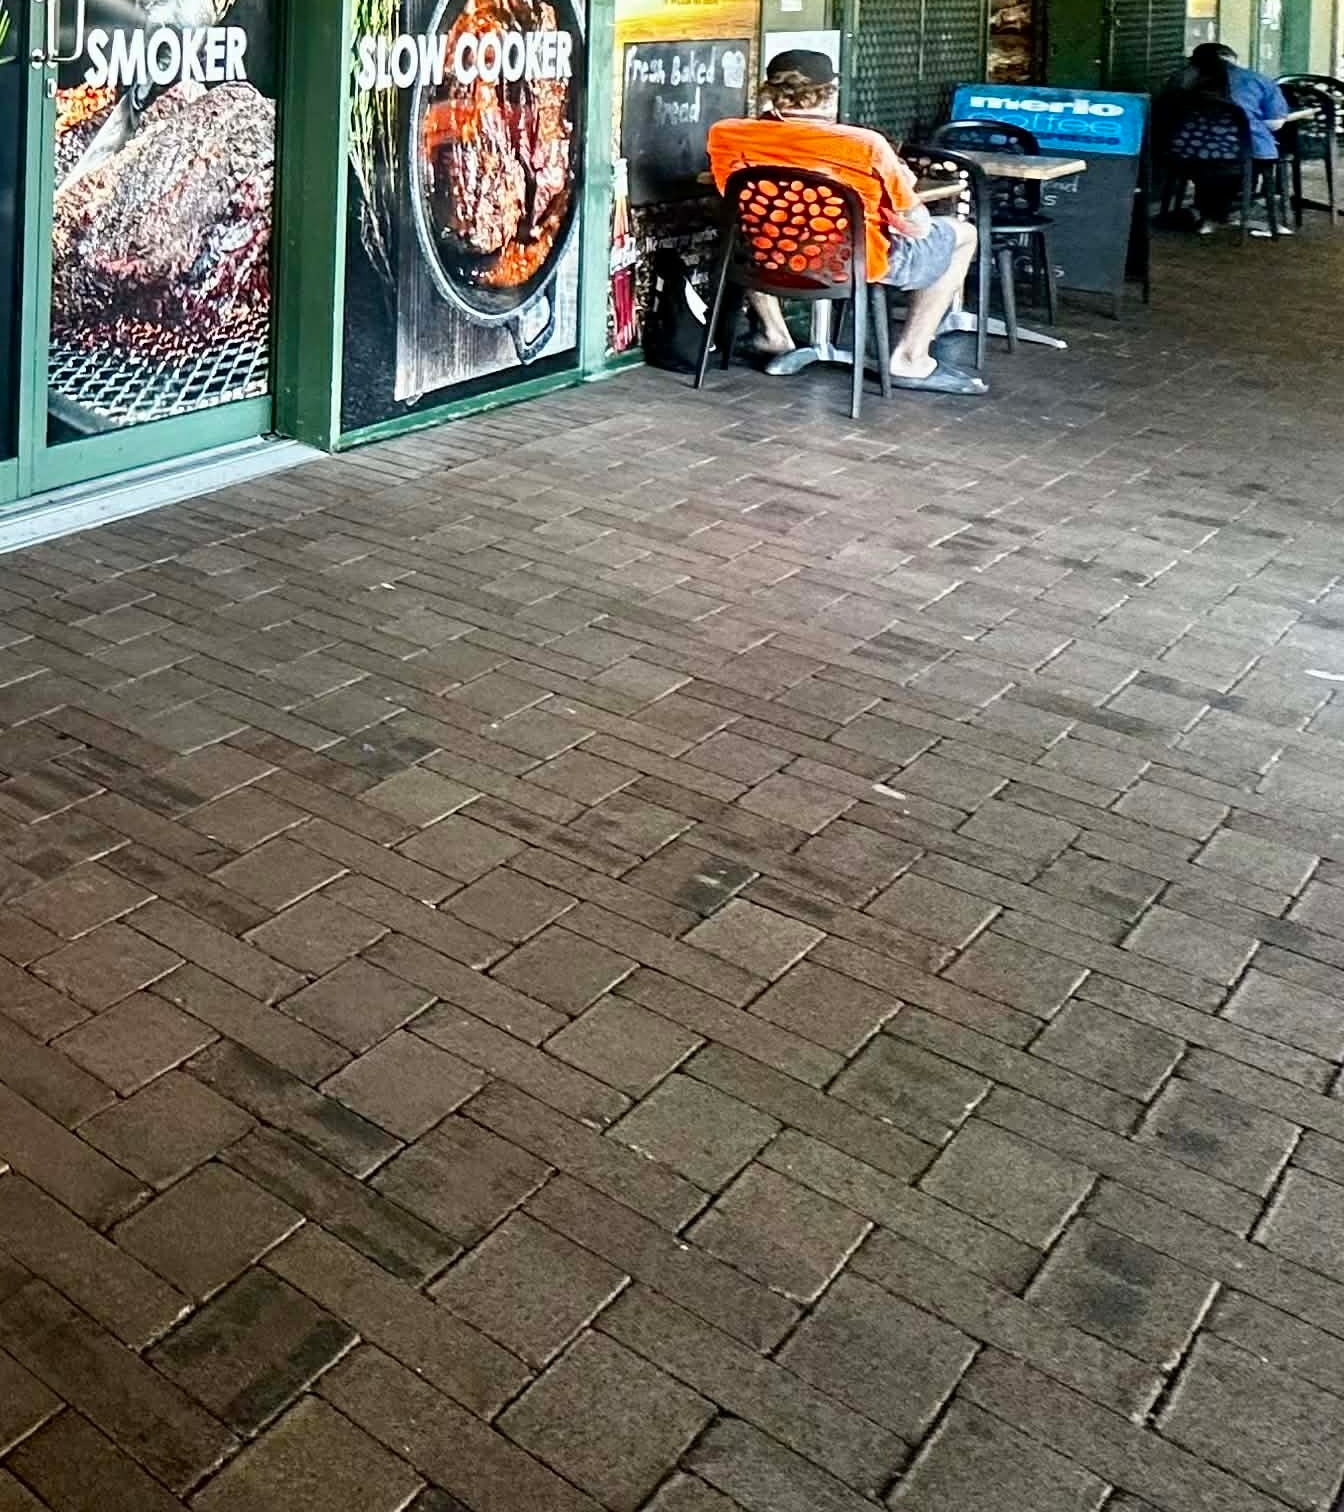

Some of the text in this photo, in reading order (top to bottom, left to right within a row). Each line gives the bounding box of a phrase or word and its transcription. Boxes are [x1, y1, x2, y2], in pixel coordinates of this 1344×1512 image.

[83, 26, 248, 88] SMOKER
[356, 31, 574, 90] SLOW COOKER
[969, 95, 1125, 117] merlo
